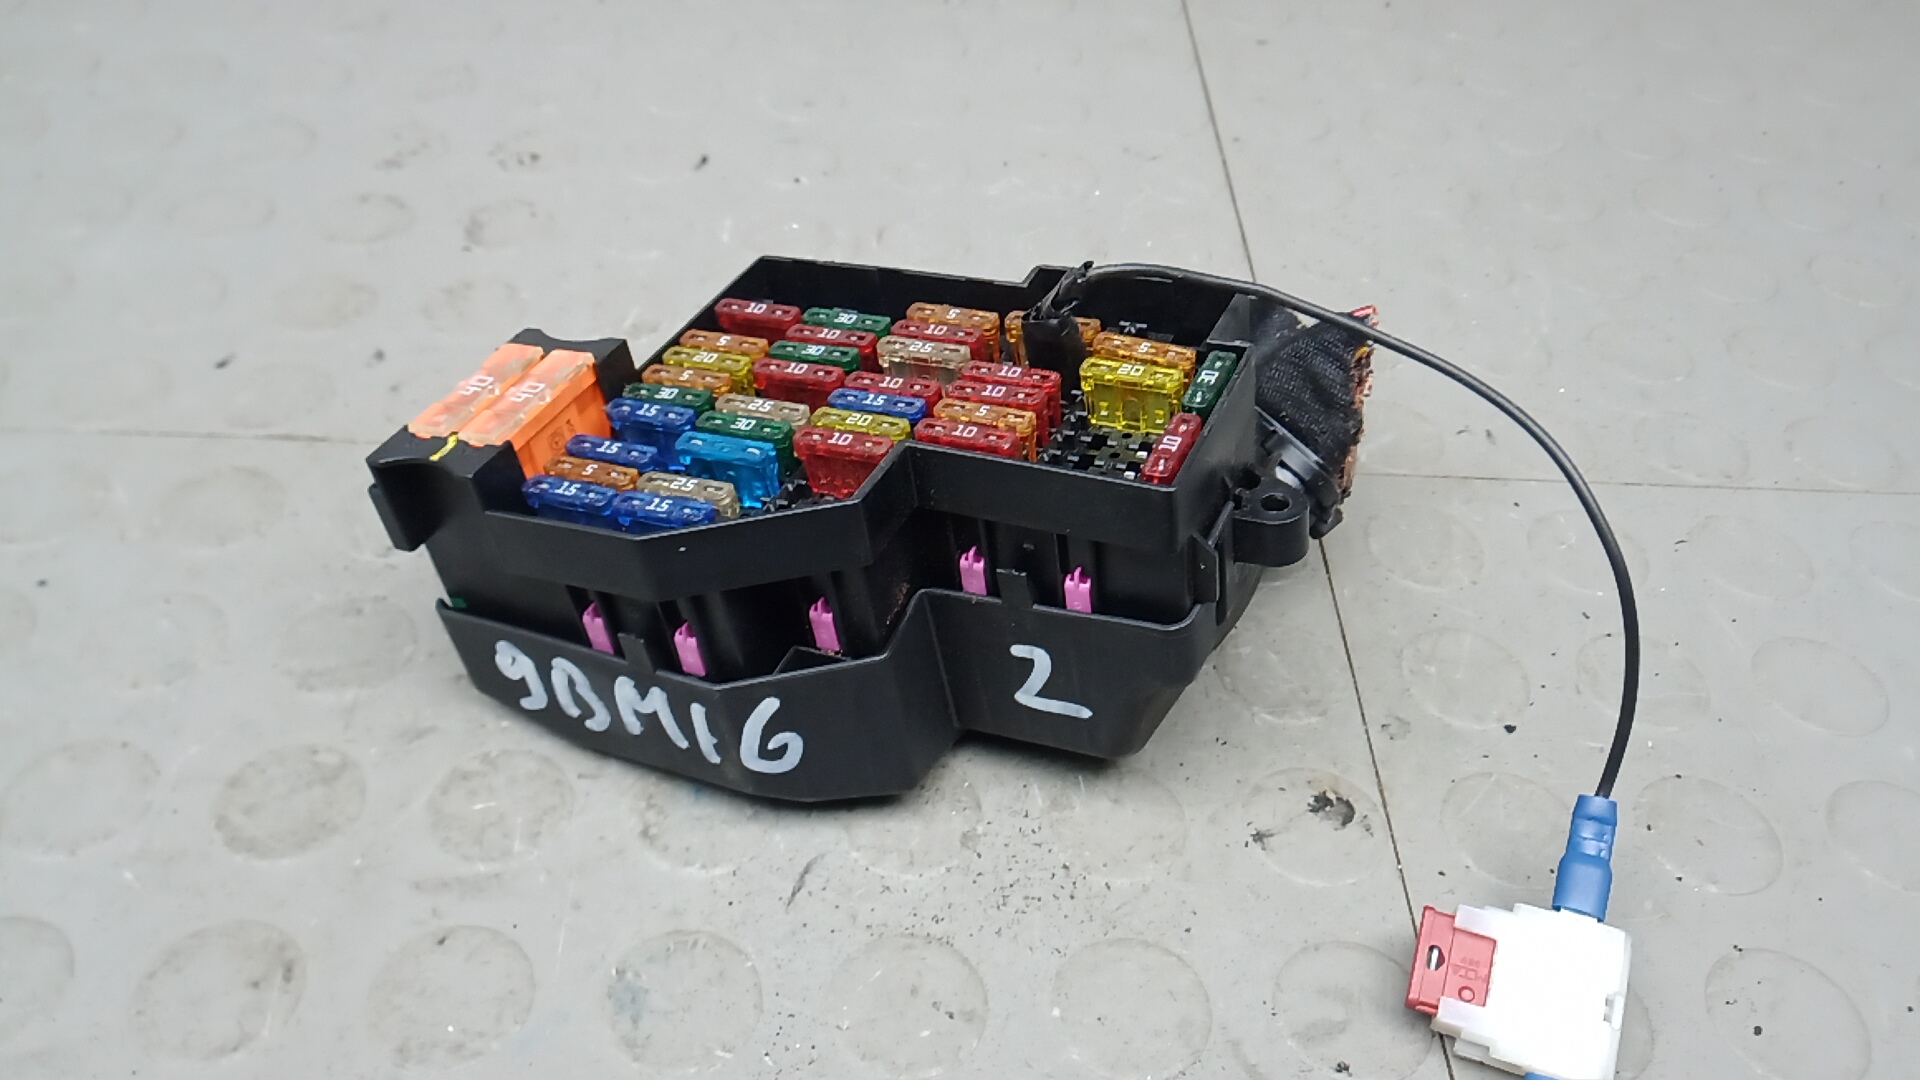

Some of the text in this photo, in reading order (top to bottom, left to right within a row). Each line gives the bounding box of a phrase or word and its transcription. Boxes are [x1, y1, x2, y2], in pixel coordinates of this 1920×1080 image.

[744, 302, 767, 314] 10
[946, 308, 960, 319] 5
[833, 312, 857, 324] 30
[816, 328, 840, 339] 10
[923, 324, 947, 335] 10
[716, 335, 731, 346] 5
[909, 341, 935, 352] 25
[801, 344, 825, 355] 30
[1138, 342, 1151, 353] 5
[692, 352, 718, 363] 20
[784, 363, 808, 374] 10
[998, 366, 1022, 377] 10
[1117, 364, 1145, 376] 20
[679, 370, 694, 381] 5
[1198, 369, 1219, 385] 30
[461, 374, 494, 396] 40
[879, 377, 903, 388] 10
[510, 381, 545, 402] 40
[654, 387, 679, 399] 30
[981, 385, 1006, 397] 10
[747, 399, 773, 411] 25
[862, 394, 885, 405] 15
[636, 405, 660, 416] 15
[975, 405, 991, 416] 5
[730, 418, 756, 430] 30
[846, 413, 872, 425] 20
[952, 424, 978, 437] 10
[827, 432, 853, 445] 10
[1158, 435, 1182, 453] 10
[596, 441, 622, 453] 15
[581, 464, 597, 475] 5
[554, 482, 580, 495] 15
[669, 478, 697, 491] 25
[645, 498, 672, 511] 15
[1010, 644, 1093, 720] 2
